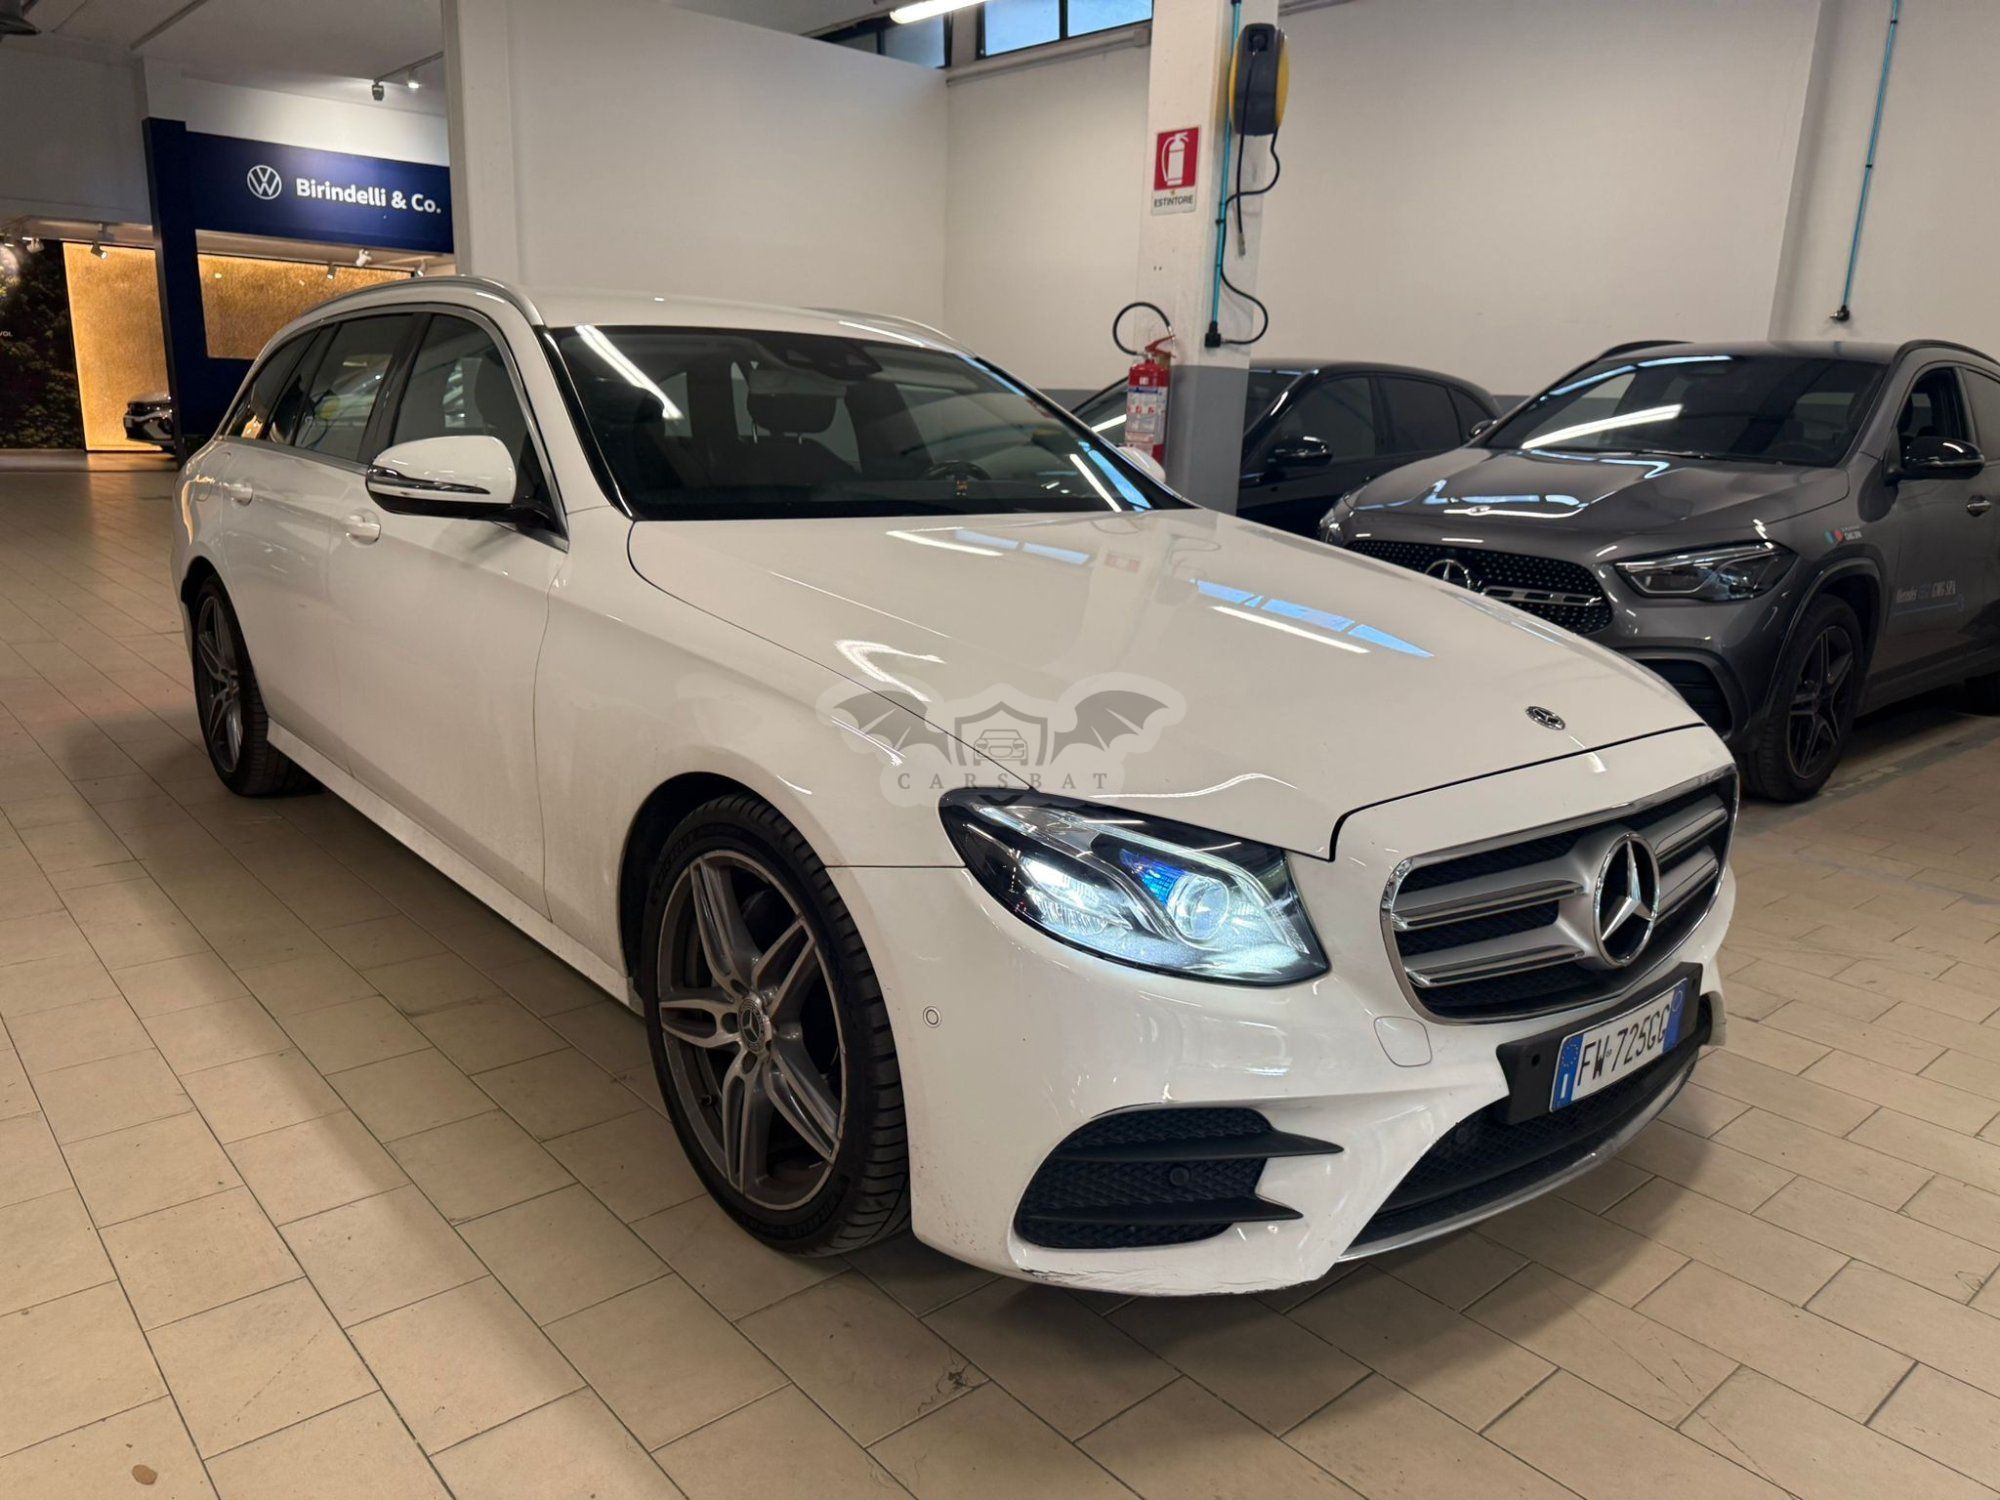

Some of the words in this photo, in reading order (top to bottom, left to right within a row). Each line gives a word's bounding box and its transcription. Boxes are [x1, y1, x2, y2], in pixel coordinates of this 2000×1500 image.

[296, 178, 387, 207] Birindelli
[391, 190, 407, 209] &
[411, 193, 442, 214] Co.
[1154, 194, 1193, 208] ESTINTORE
